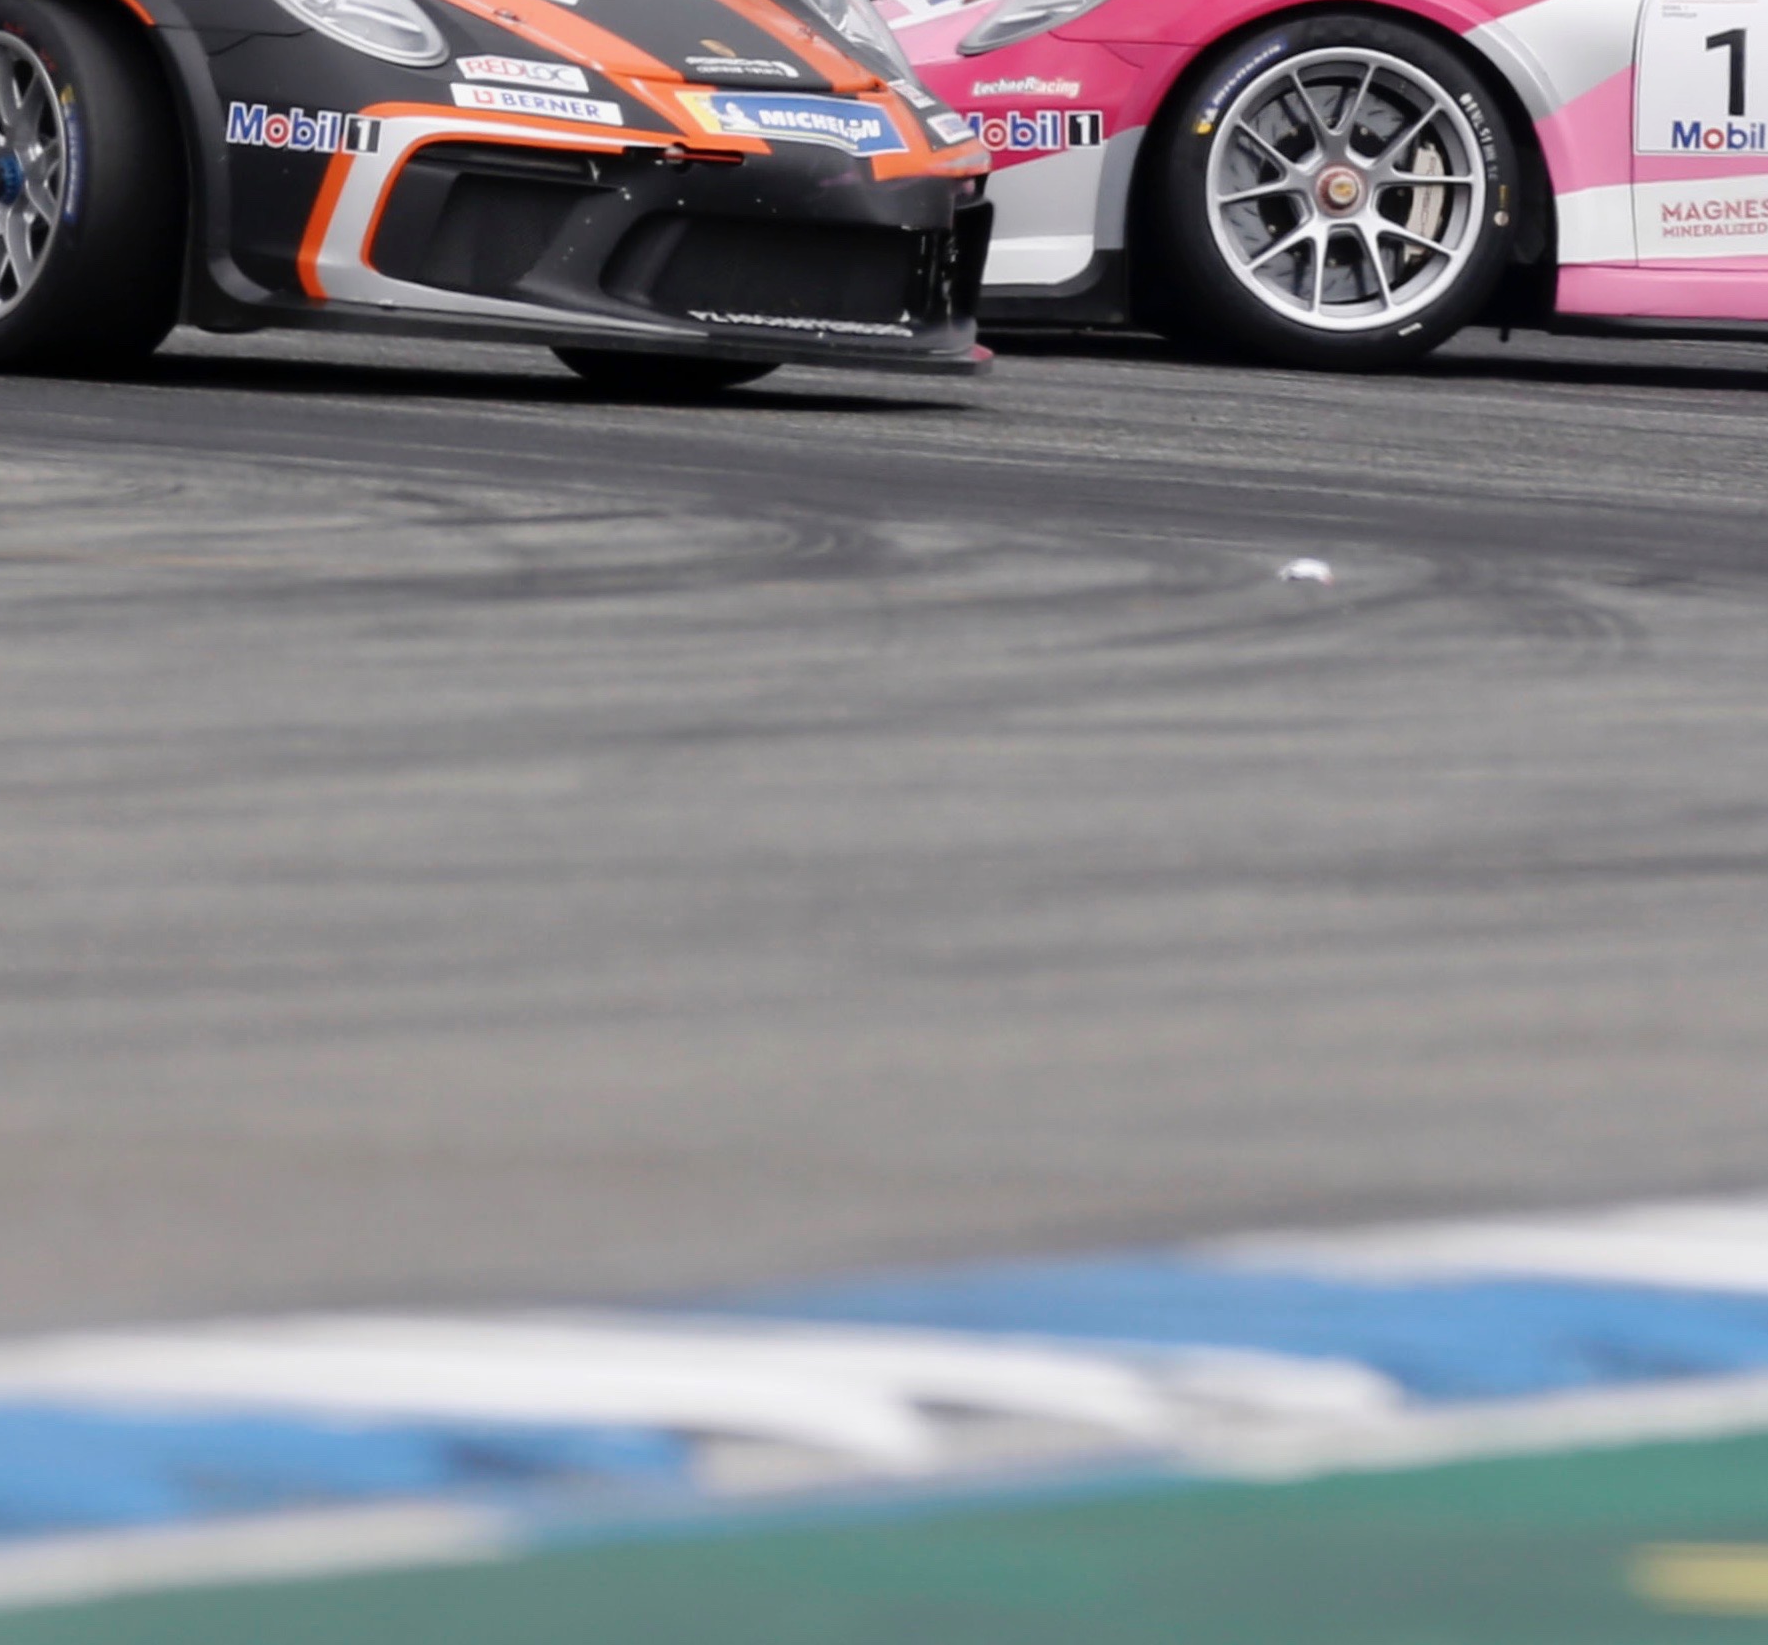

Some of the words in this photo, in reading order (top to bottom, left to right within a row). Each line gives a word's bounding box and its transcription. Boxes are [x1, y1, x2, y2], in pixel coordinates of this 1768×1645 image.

[464, 57, 577, 87] REDLOC
[1705, 27, 1748, 117] 1
[500, 91, 602, 121] BERNER
[227, 102, 341, 152] Mobil
[344, 114, 383, 155] 1
[1064, 110, 1104, 149] 1
[1670, 120, 1767, 151] Mobil
[1662, 220, 1768, 239] MINERALIZED
